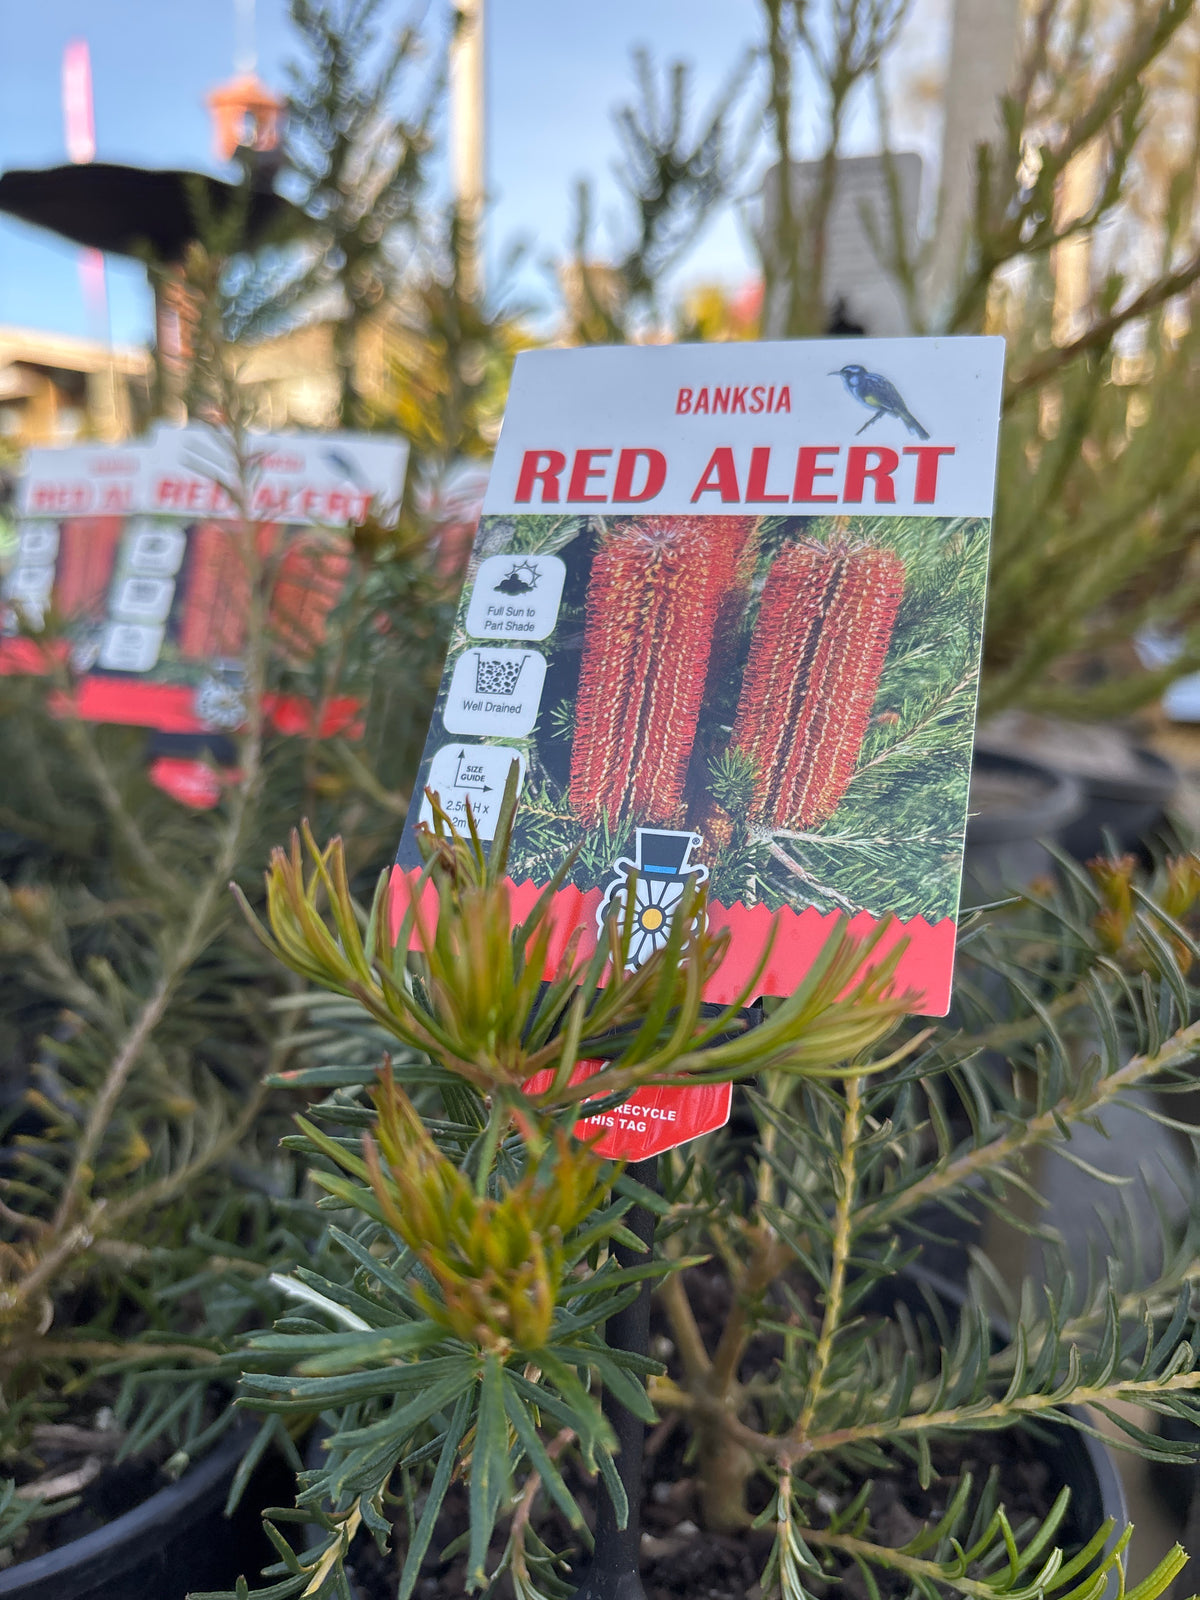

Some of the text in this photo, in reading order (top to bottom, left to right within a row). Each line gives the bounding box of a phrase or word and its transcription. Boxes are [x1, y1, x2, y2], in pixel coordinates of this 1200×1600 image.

[676, 386, 791, 415] BANKSIA
[514, 446, 955, 504] RED ALERT
[487, 606, 536, 618] Full Sun to
[484, 620, 535, 632] Part Shade
[463, 700, 522, 714] Well Drained
[466, 765, 484, 774] SIZE
[460, 773, 486, 783] GUIDE
[473, 802, 482, 813] H
[482, 805, 490, 814] x
[613, 1103, 677, 1121] RECYCLE
[619, 1118, 647, 1133] TAG
